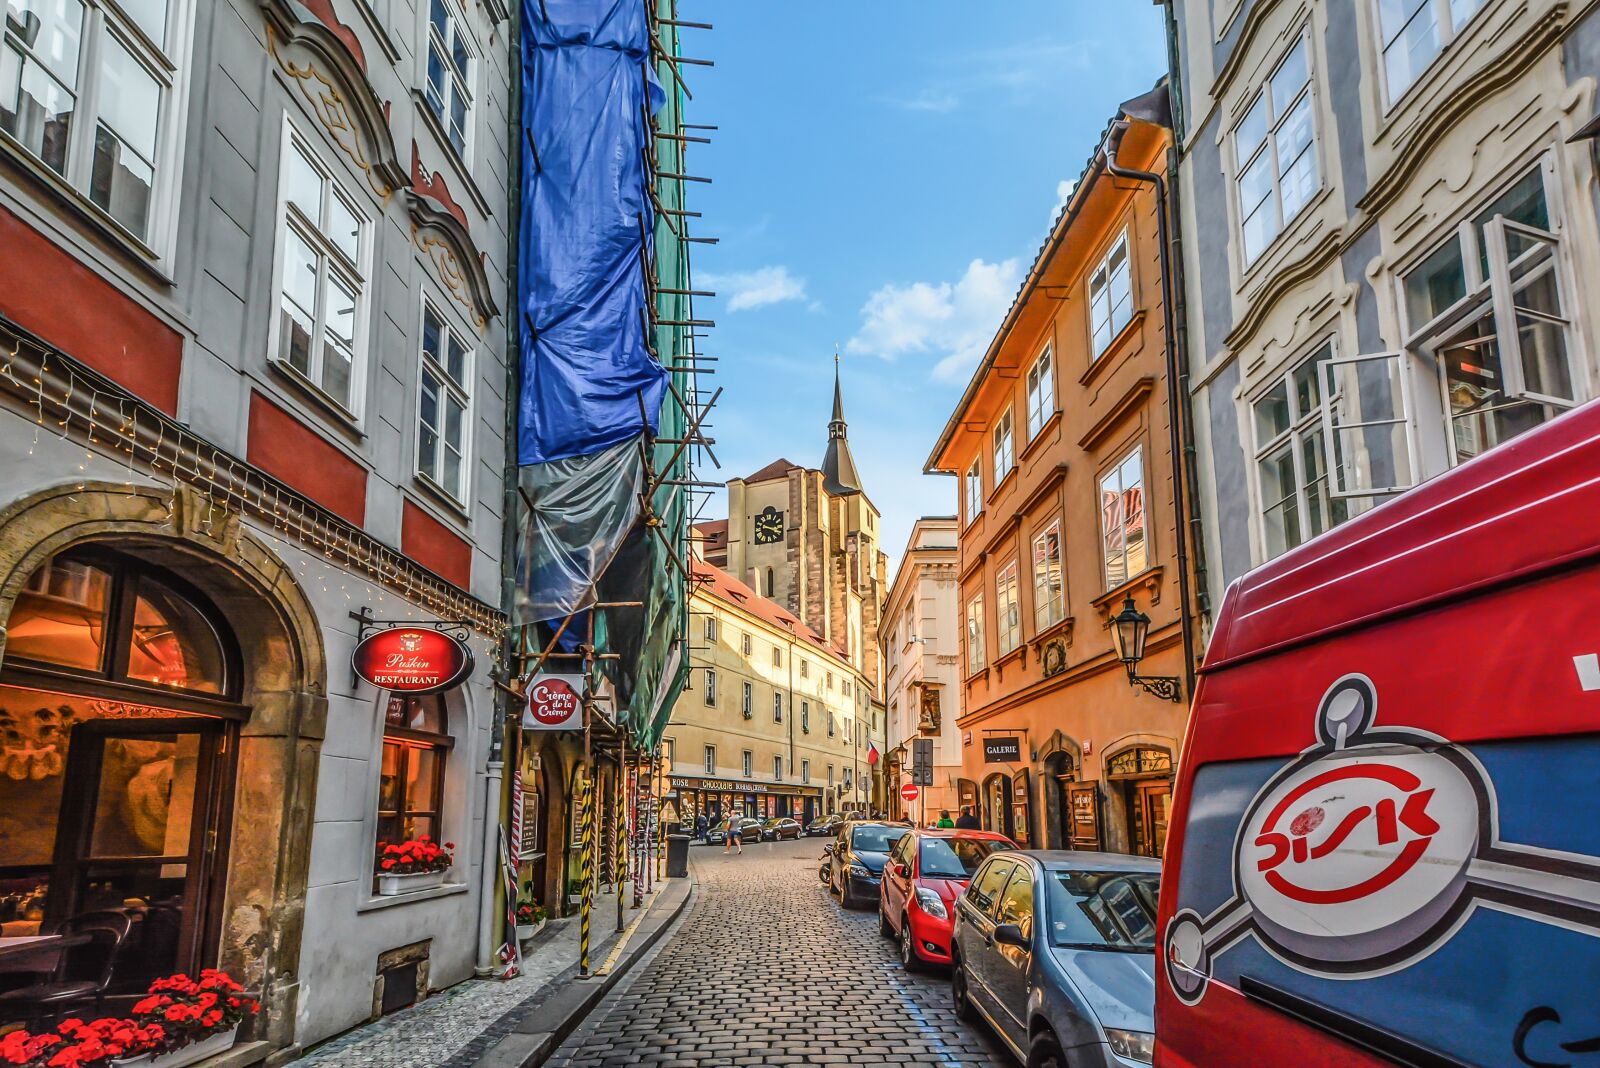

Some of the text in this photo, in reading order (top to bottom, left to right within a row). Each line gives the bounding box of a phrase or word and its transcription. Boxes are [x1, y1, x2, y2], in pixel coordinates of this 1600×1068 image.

[386, 653, 430, 668] Puškin
[374, 675, 439, 685] RESTAURANT
[986, 746, 1017, 754] GALERIE
[672, 778, 689, 787] ROSE
